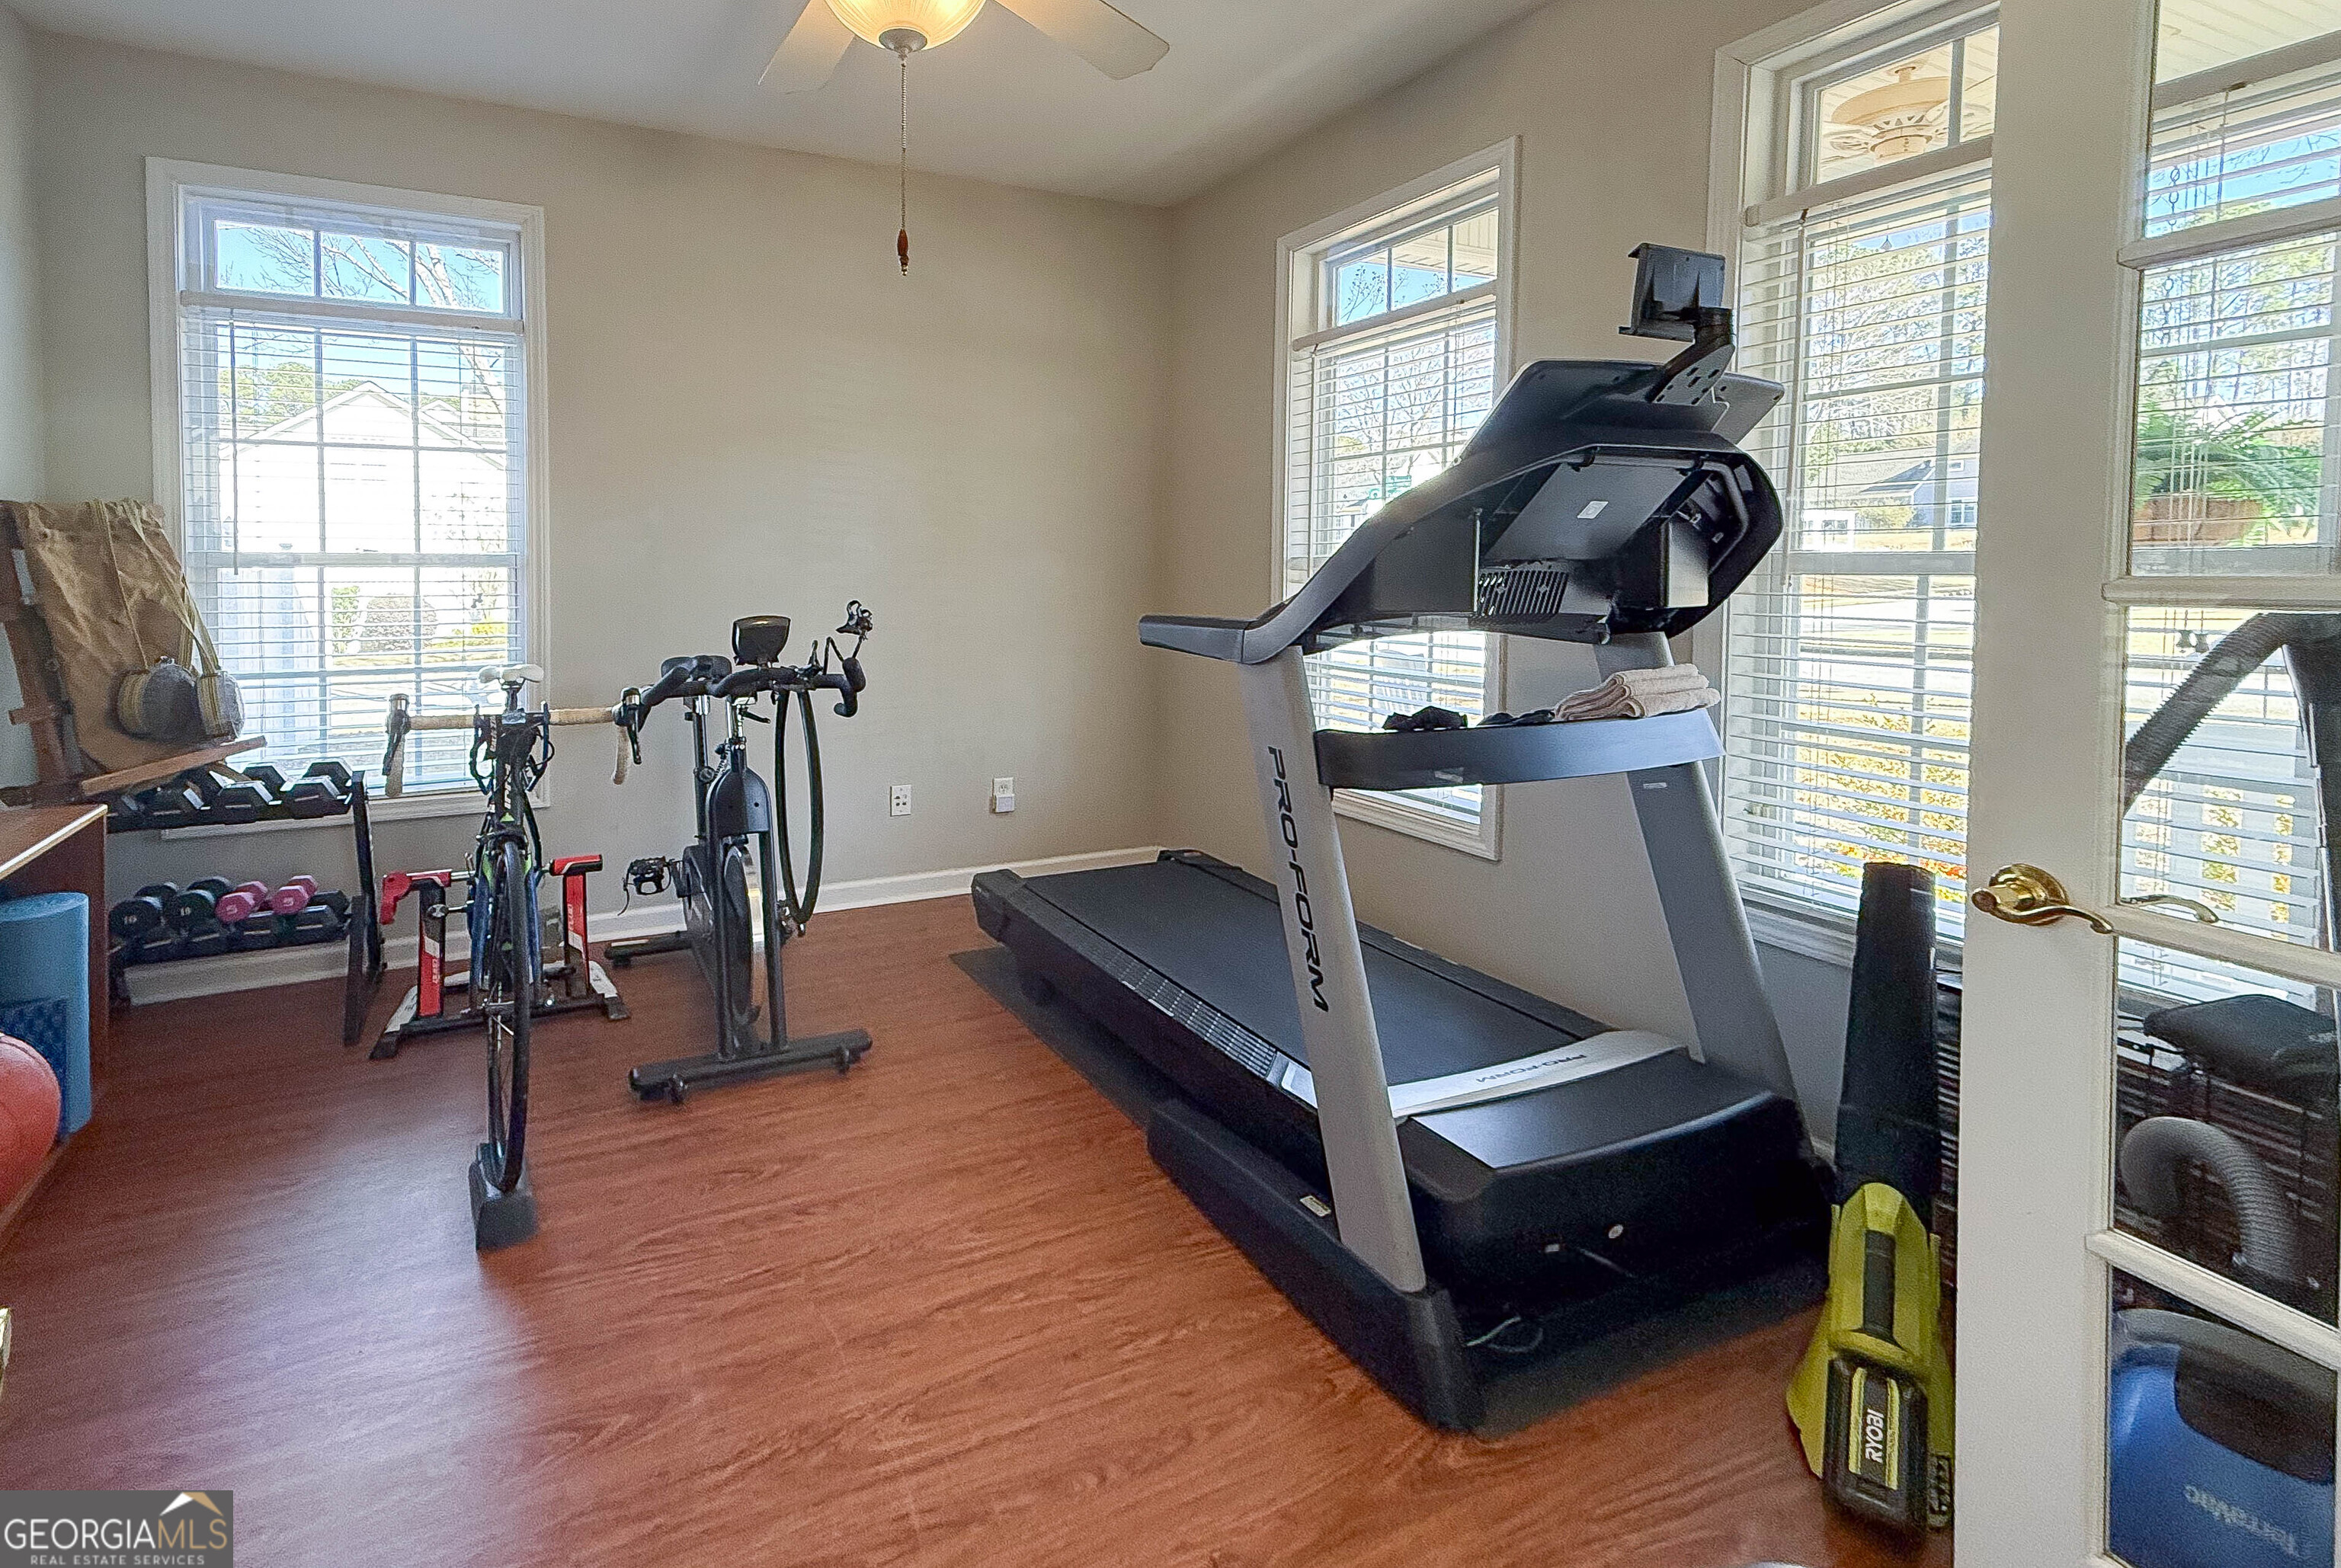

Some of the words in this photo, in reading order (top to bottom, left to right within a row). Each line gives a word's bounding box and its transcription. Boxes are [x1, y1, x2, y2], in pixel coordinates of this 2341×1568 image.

[1267, 745, 1329, 1013] PRO-FORM
[1476, 1054, 1587, 1083] PRO-FORM
[1865, 1408, 1885, 1464] RYOBI
